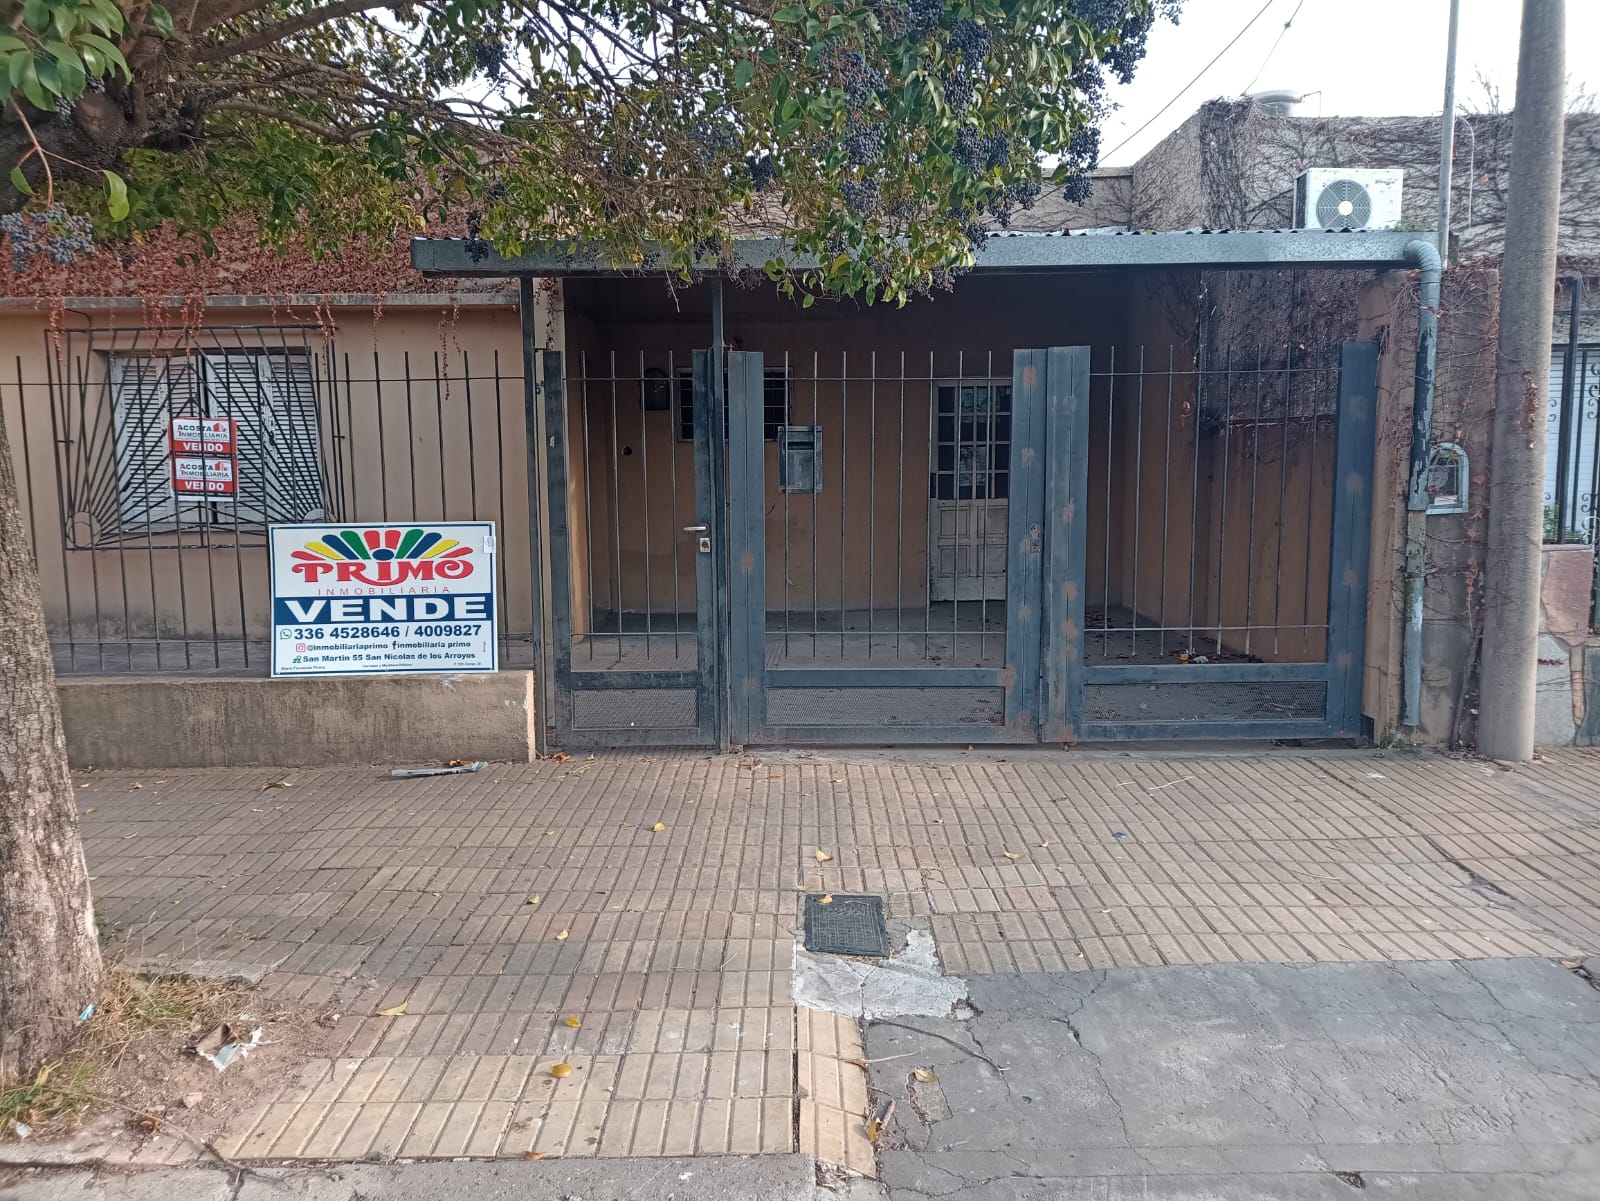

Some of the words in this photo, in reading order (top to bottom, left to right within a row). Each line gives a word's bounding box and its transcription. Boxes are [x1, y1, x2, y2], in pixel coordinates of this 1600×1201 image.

[291, 560, 474, 586] PRIMO
[318, 586, 450, 596] INMOBILIARIA
[284, 597, 487, 622] VENDE
[294, 628, 324, 640] 336
[330, 626, 400, 638] 4528646
[414, 624, 482, 637] 4009827
[448, 642, 471, 650] primo
